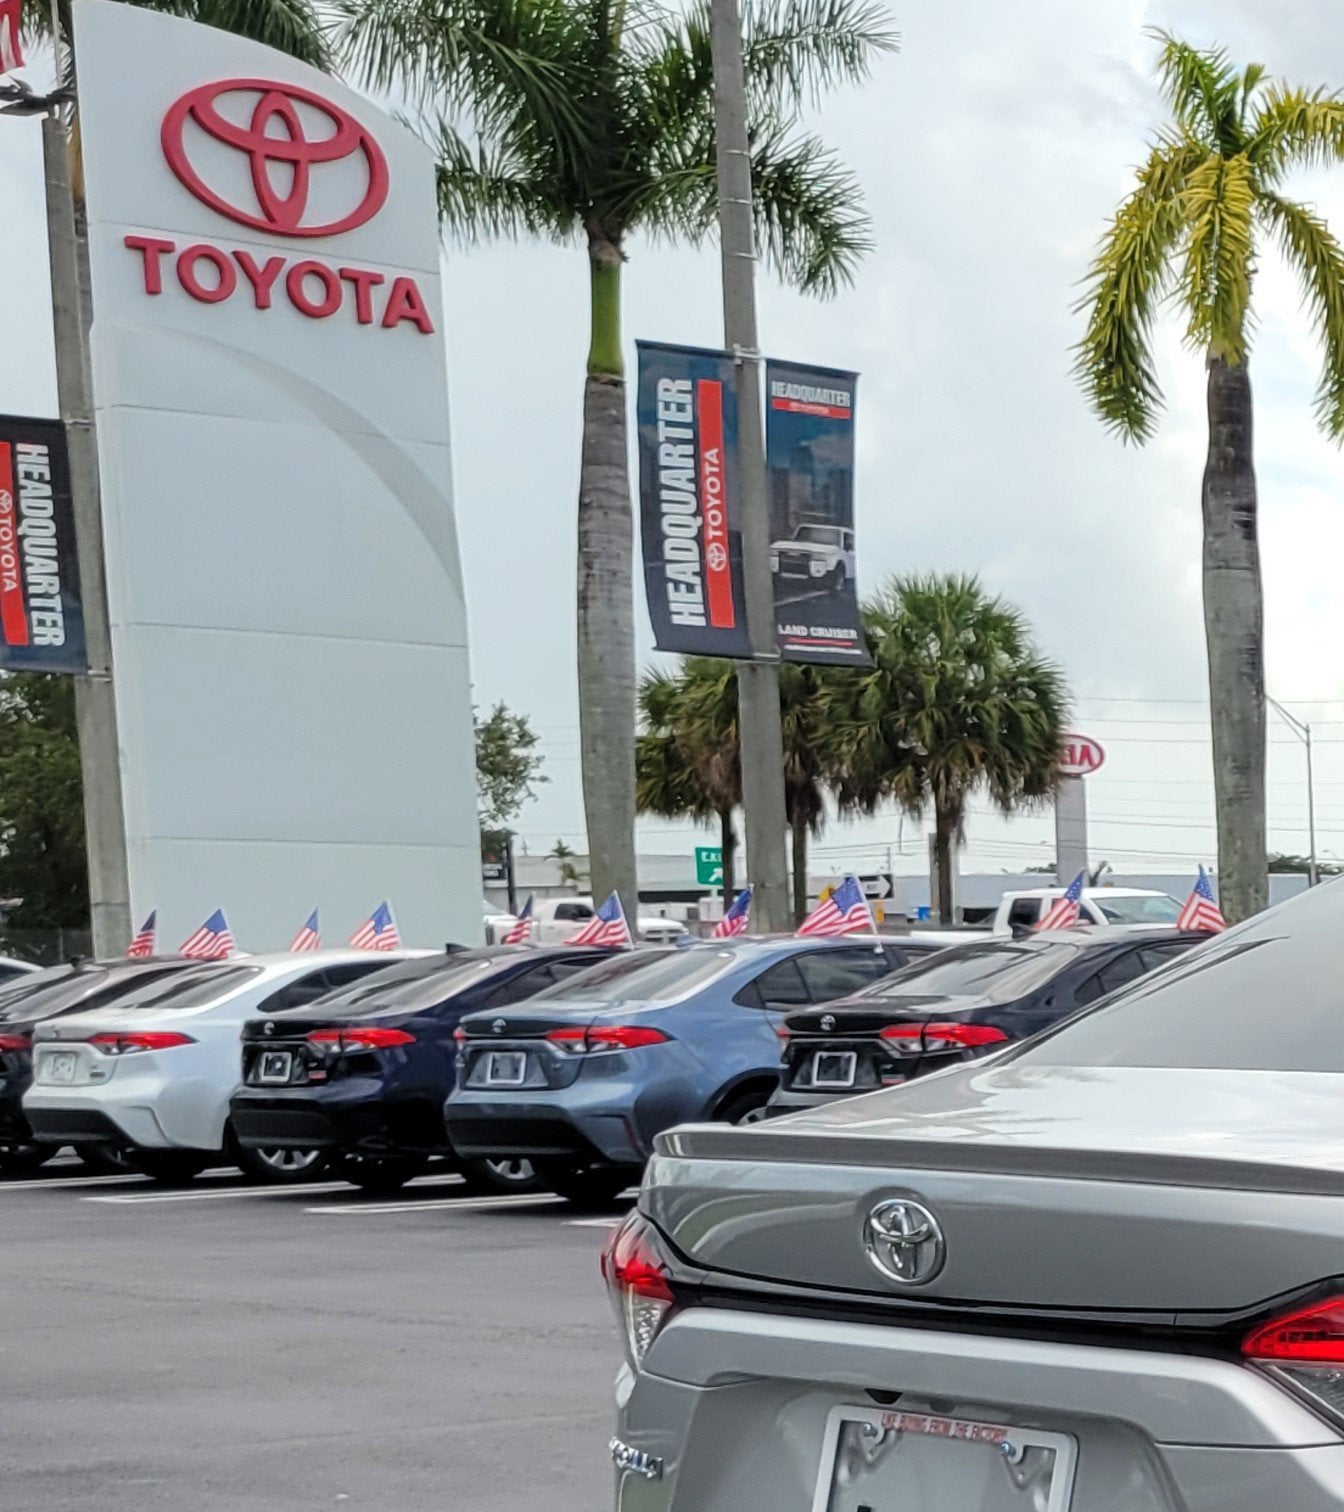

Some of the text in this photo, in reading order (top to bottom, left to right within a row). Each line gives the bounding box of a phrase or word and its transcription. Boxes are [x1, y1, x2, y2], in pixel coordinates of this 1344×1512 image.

[124, 235, 435, 334] TOYOTA
[657, 378, 706, 627] HEADQUARTER
[705, 447, 724, 539] TOYOTA
[0, 516, 17, 592] TOYOTA
[15, 442, 66, 647] HEADQUARTER
[701, 851, 723, 863] EXI
